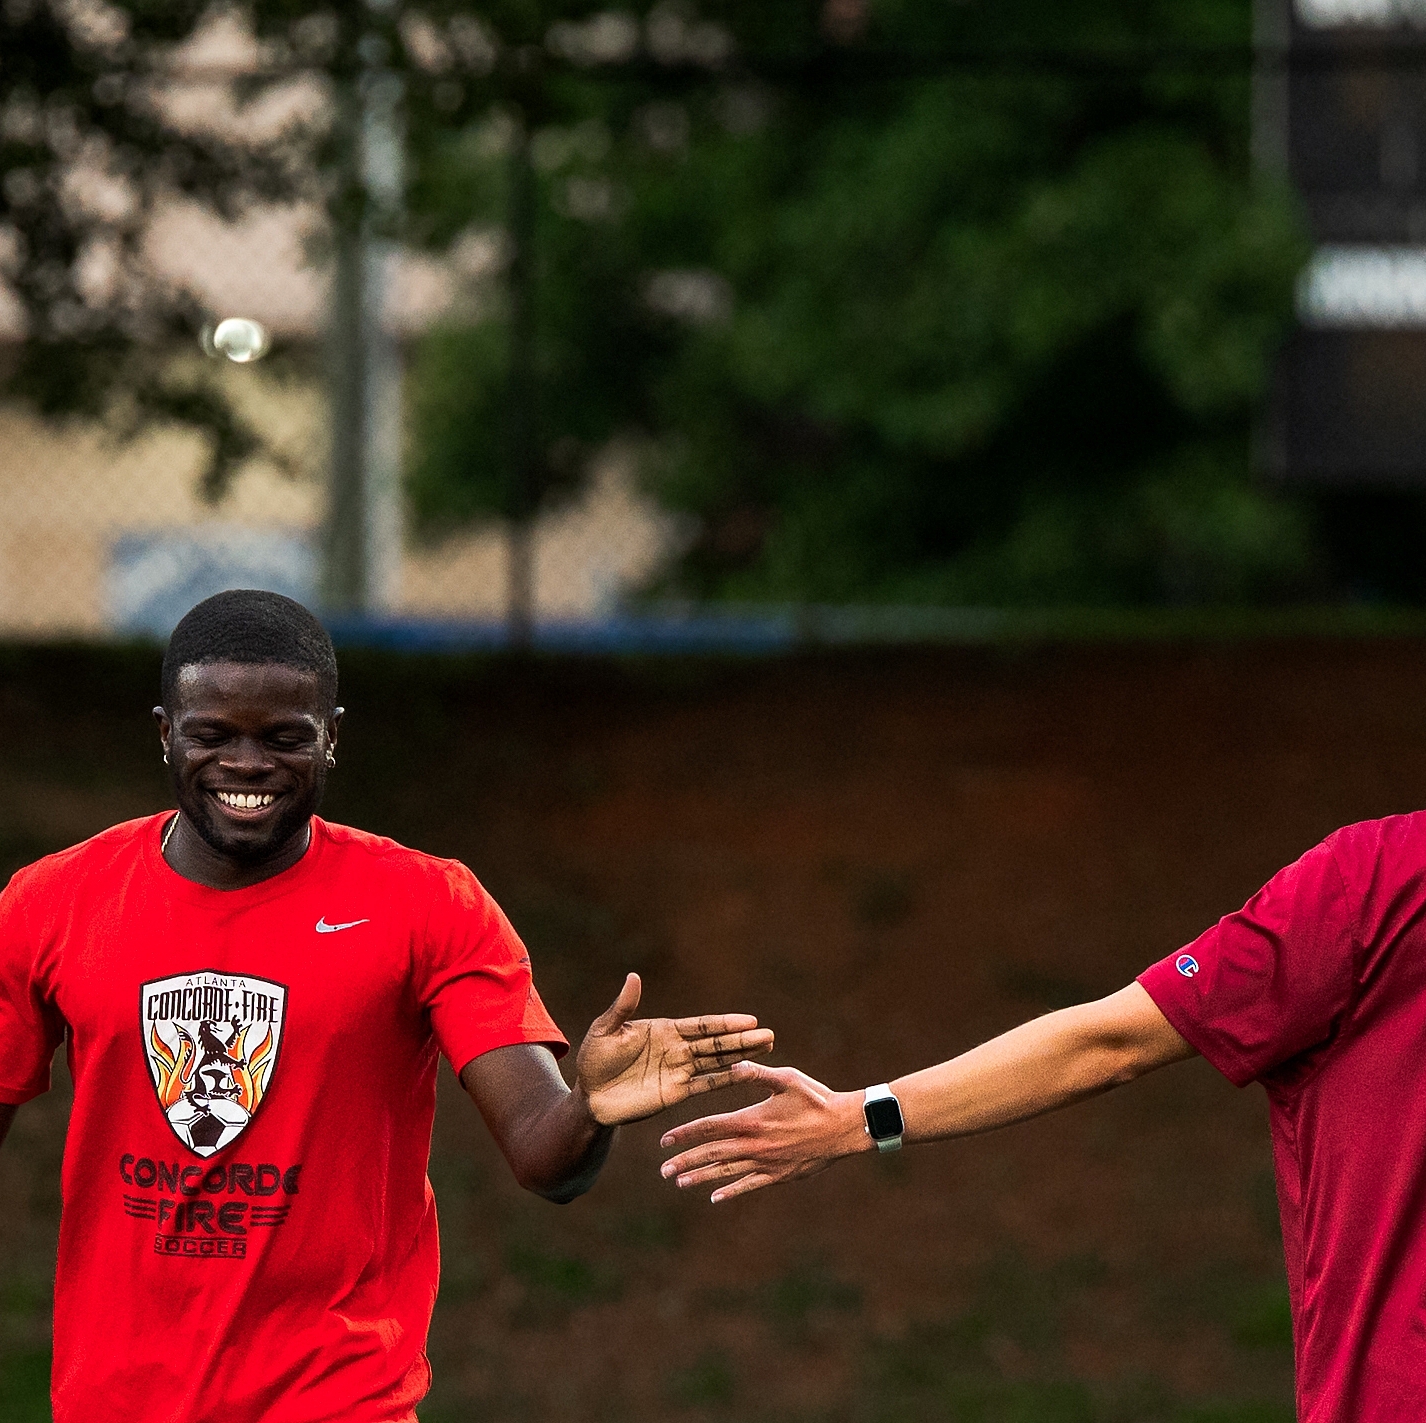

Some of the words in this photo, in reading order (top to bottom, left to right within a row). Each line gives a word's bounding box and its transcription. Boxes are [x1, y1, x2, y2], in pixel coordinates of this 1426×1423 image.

[185, 976, 246, 988] ATLANTA
[241, 989, 280, 1023] FIRE
[157, 1198, 249, 1235] FIRE
[154, 1235, 247, 1255] SOCCER
